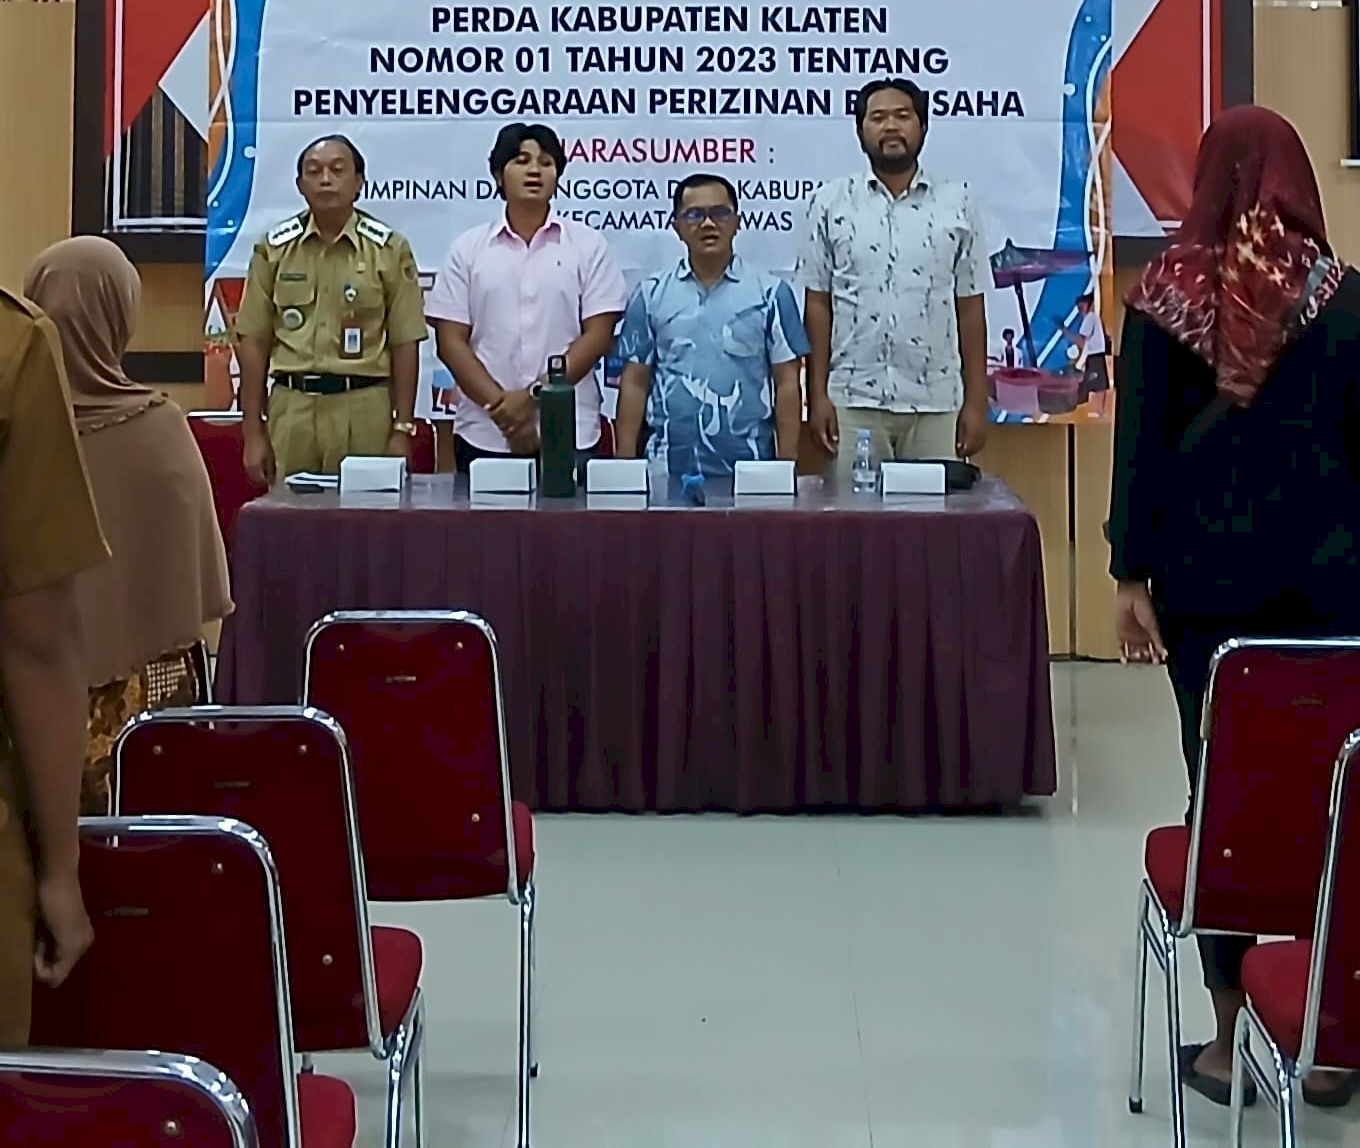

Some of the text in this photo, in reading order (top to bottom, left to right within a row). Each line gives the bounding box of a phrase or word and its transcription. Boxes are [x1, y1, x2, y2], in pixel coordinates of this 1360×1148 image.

[432, 6, 887, 33] PERDA KABUPATEN KLATEN
[370, 46, 949, 74] NOMOR 01 TAHUN 2023 TENTANG
[294, 88, 636, 116] PENYELENGGARAAN
[649, 88, 831, 116] PERIZINAN
[364, 179, 467, 200] IMPINAN
[554, 179, 659, 200] NGGOTA
